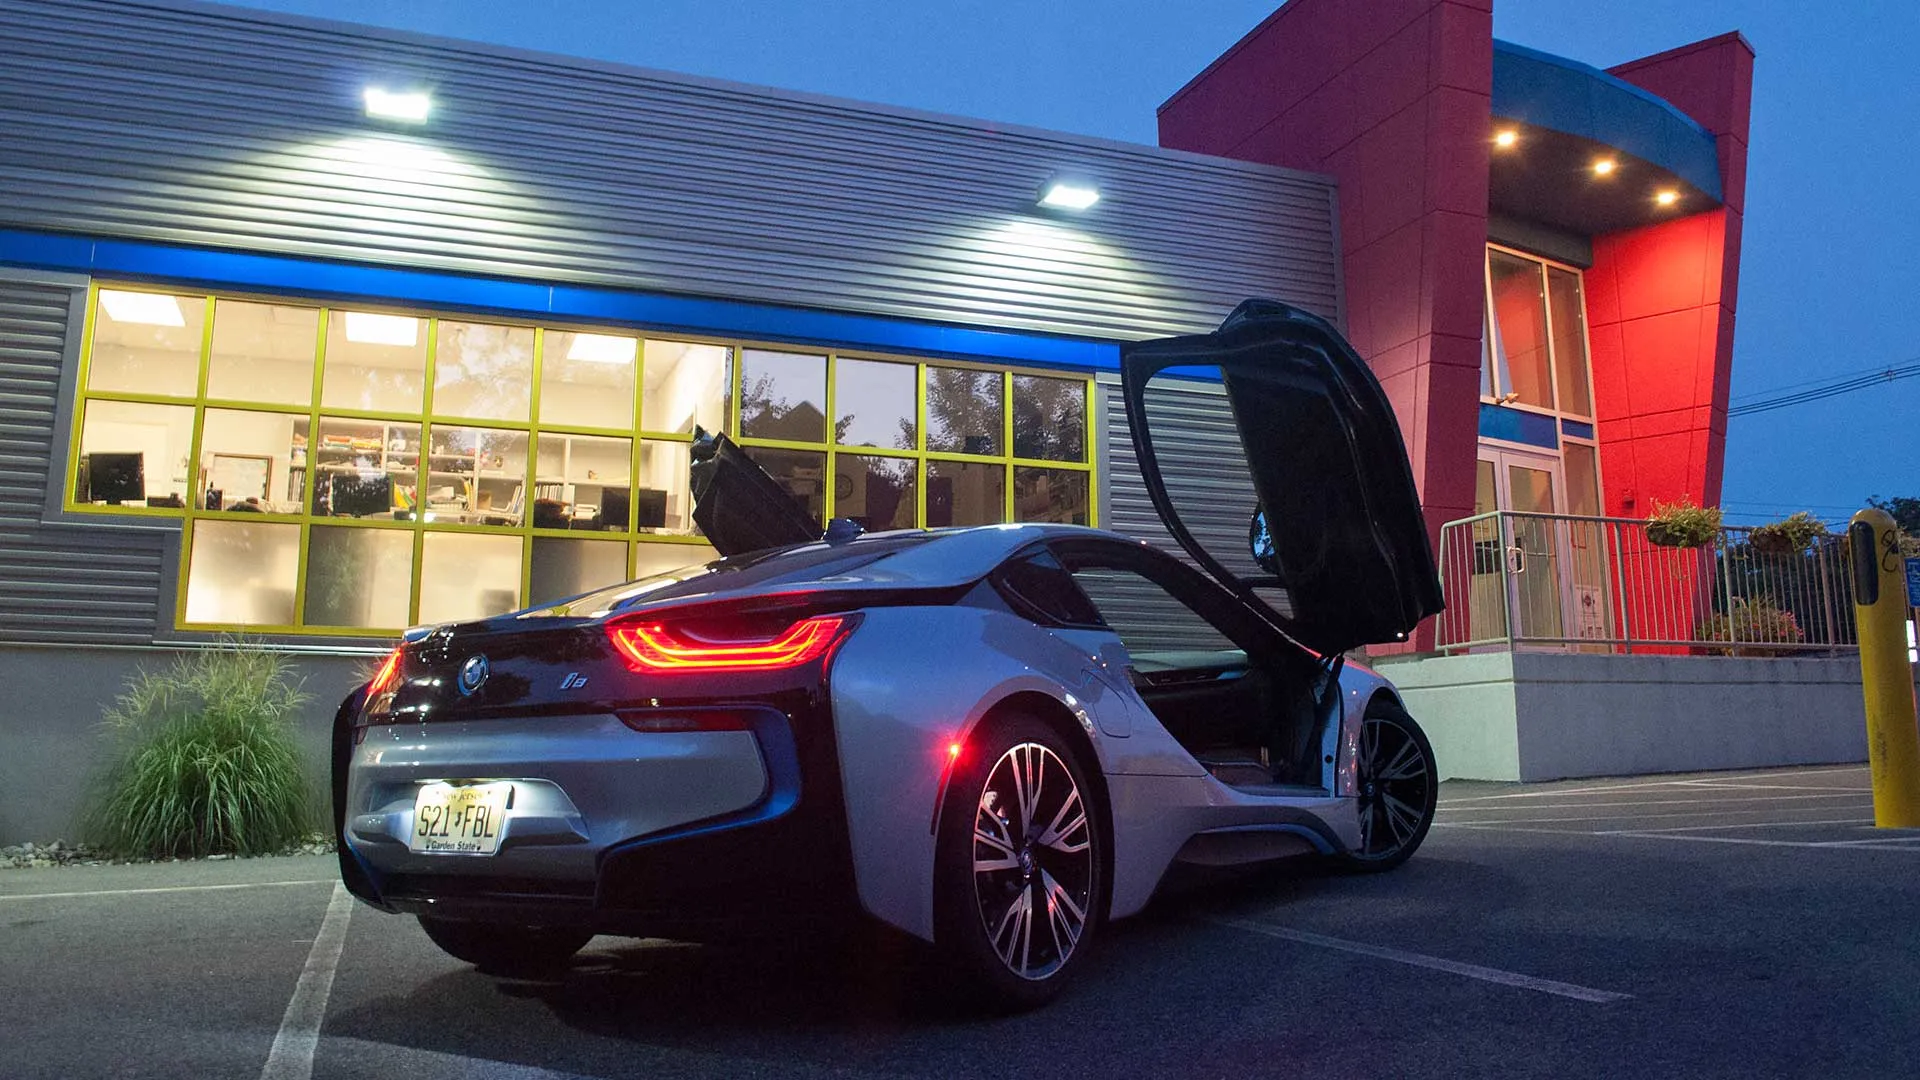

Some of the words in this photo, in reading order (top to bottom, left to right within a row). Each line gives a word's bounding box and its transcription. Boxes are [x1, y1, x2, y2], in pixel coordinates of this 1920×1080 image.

[418, 805, 450, 837] S21
[461, 805, 494, 838] FBL
[431, 841, 455, 850] Garden
[457, 841, 476, 851] State
